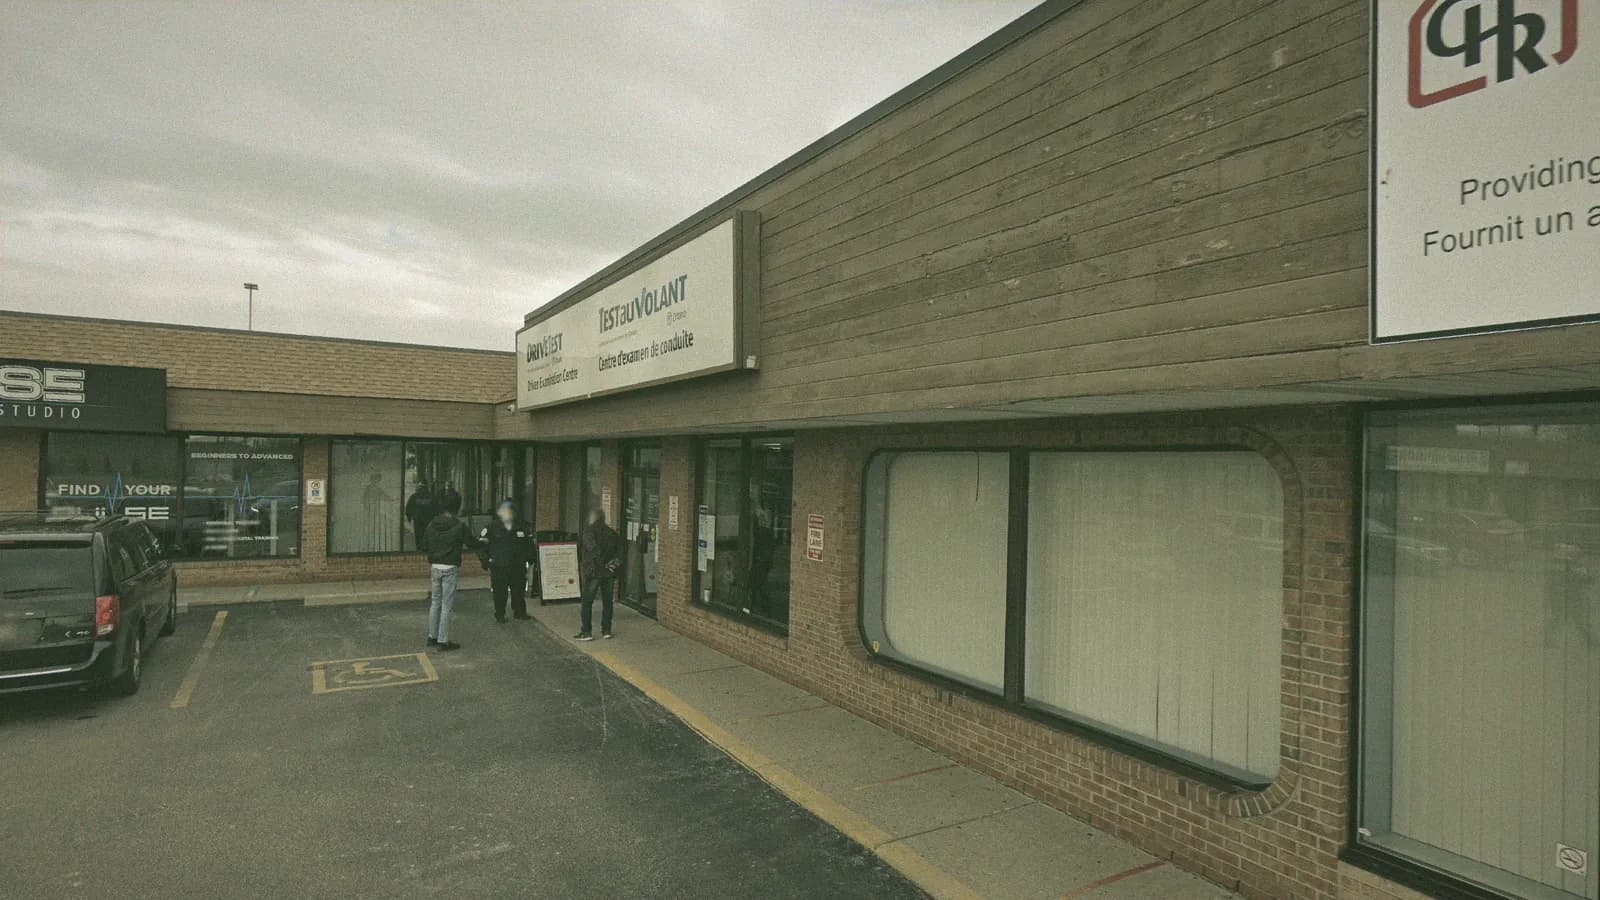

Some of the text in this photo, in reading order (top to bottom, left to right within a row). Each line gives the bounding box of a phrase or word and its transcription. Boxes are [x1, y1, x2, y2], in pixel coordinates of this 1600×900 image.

[1460, 156, 1600, 206] Providing
[1423, 216, 1524, 257] Fournit
[1536, 210, 1573, 236] un
[598, 355, 617, 372] Centre
[617, 347, 649, 366] d'examen
[650, 340, 659, 358] de
[660, 329, 694, 355] conduite
[563, 368, 578, 383] Centre
[58, 484, 171, 496] FIND YOUR
